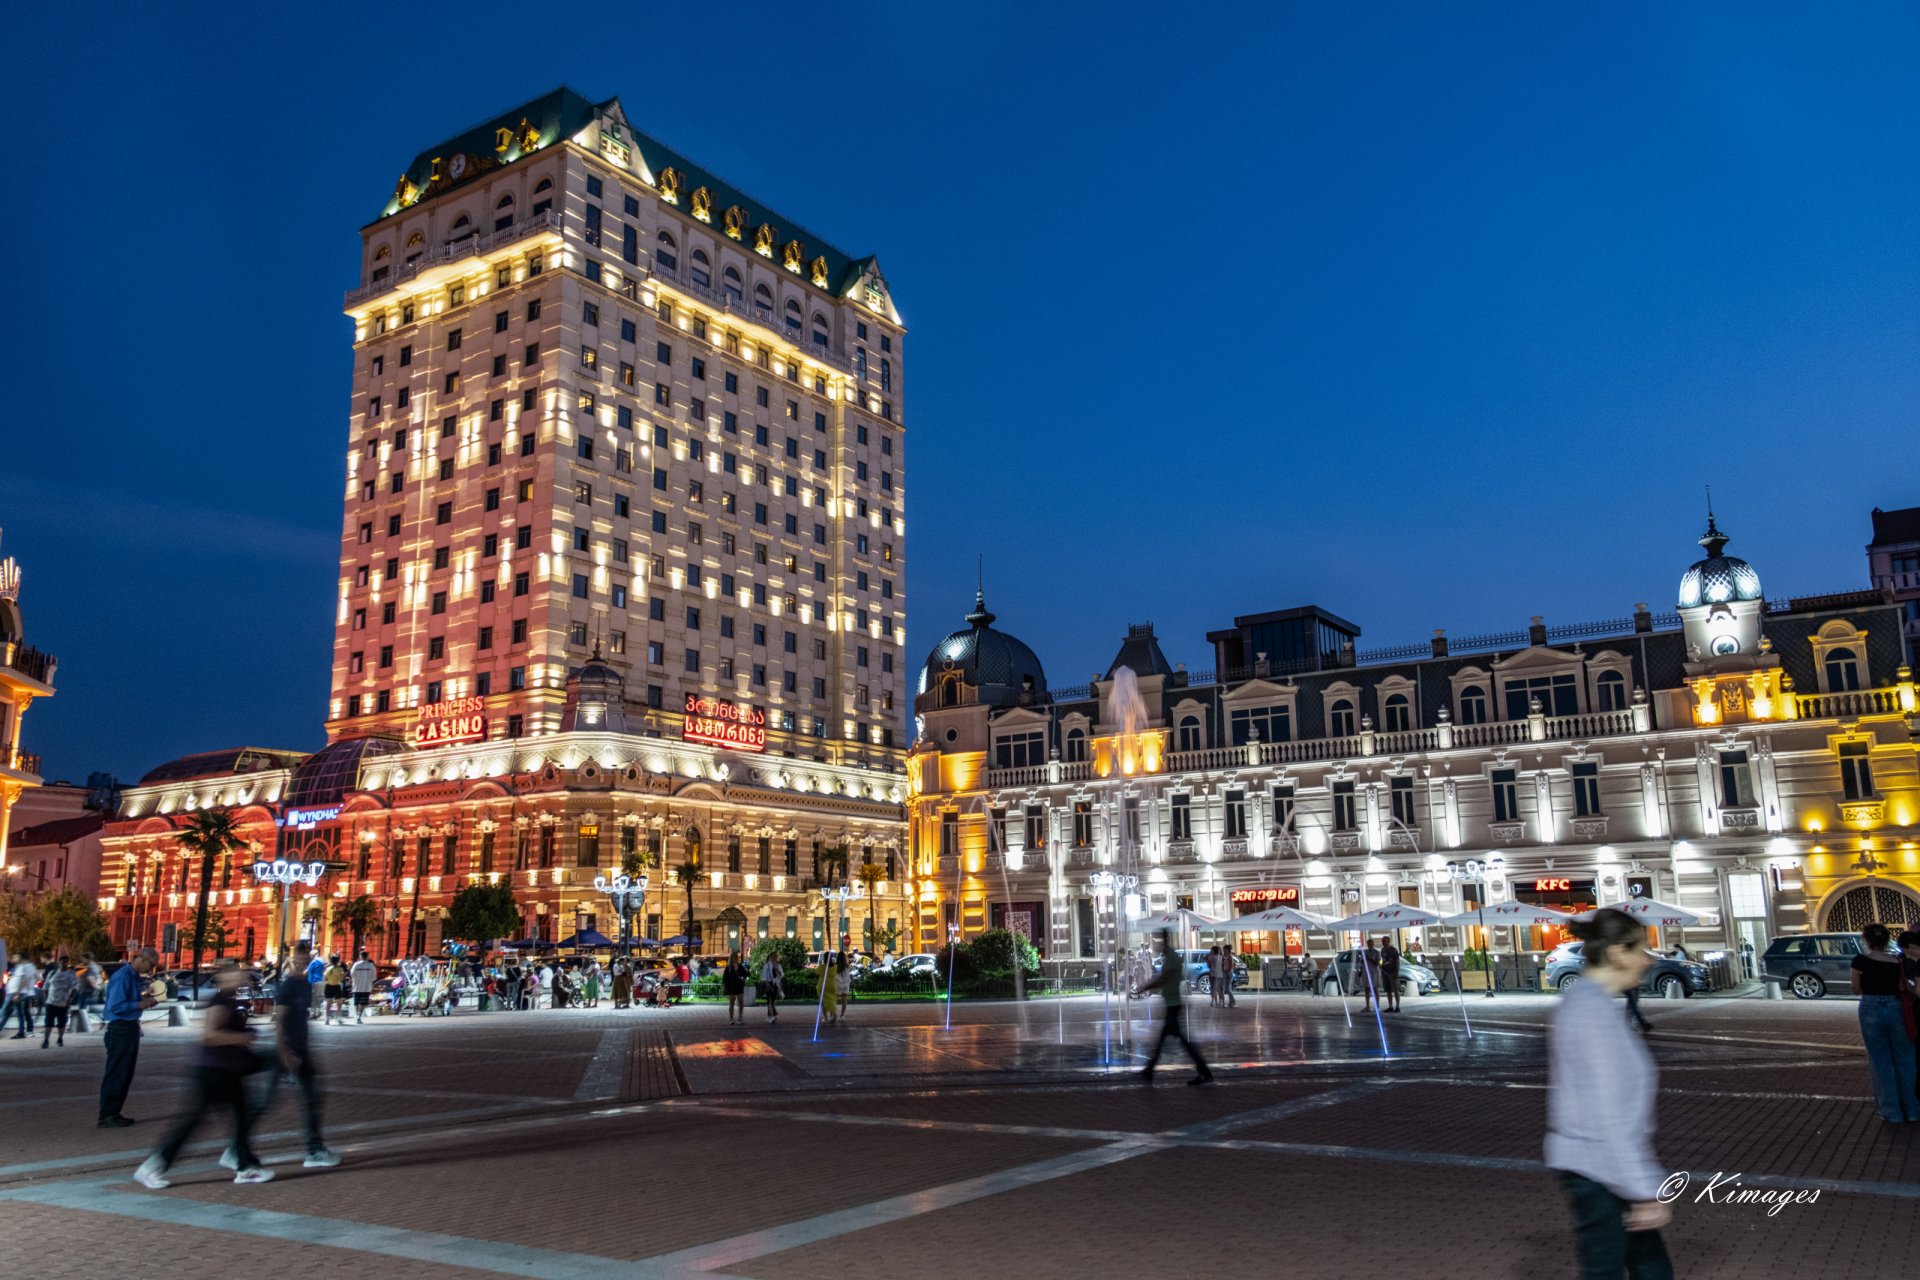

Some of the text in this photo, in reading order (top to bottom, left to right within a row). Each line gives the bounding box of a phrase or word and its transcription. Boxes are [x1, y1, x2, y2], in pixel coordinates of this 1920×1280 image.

[417, 696, 483, 719] PRINCESS
[415, 715, 482, 741] CASINO
[685, 716, 765, 745] სამორინე
[1536, 879, 1570, 891] KFC
